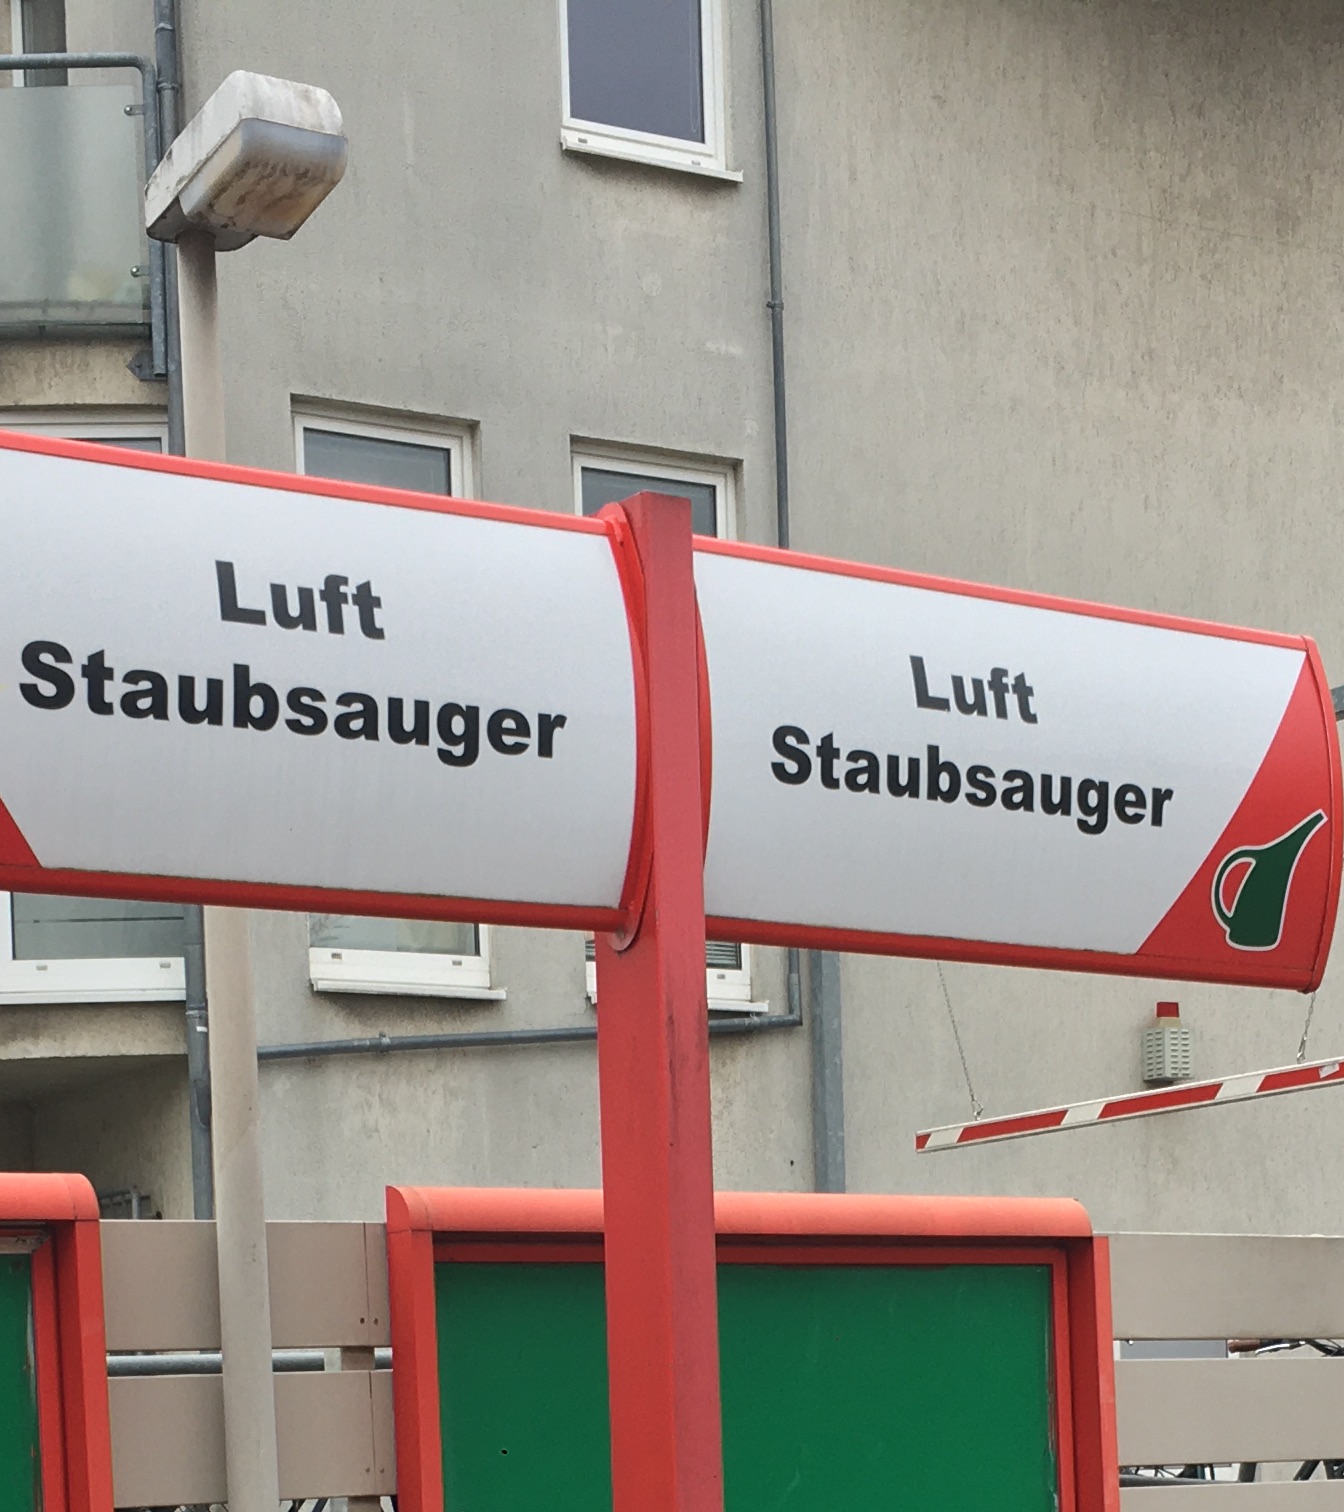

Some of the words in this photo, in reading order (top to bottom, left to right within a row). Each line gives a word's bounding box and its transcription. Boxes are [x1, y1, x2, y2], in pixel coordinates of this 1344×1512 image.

[214, 559, 386, 641] Luft
[18, 639, 568, 768] Staubsauger
[909, 654, 1039, 725] Luft
[770, 724, 1175, 836] Staubsauger
